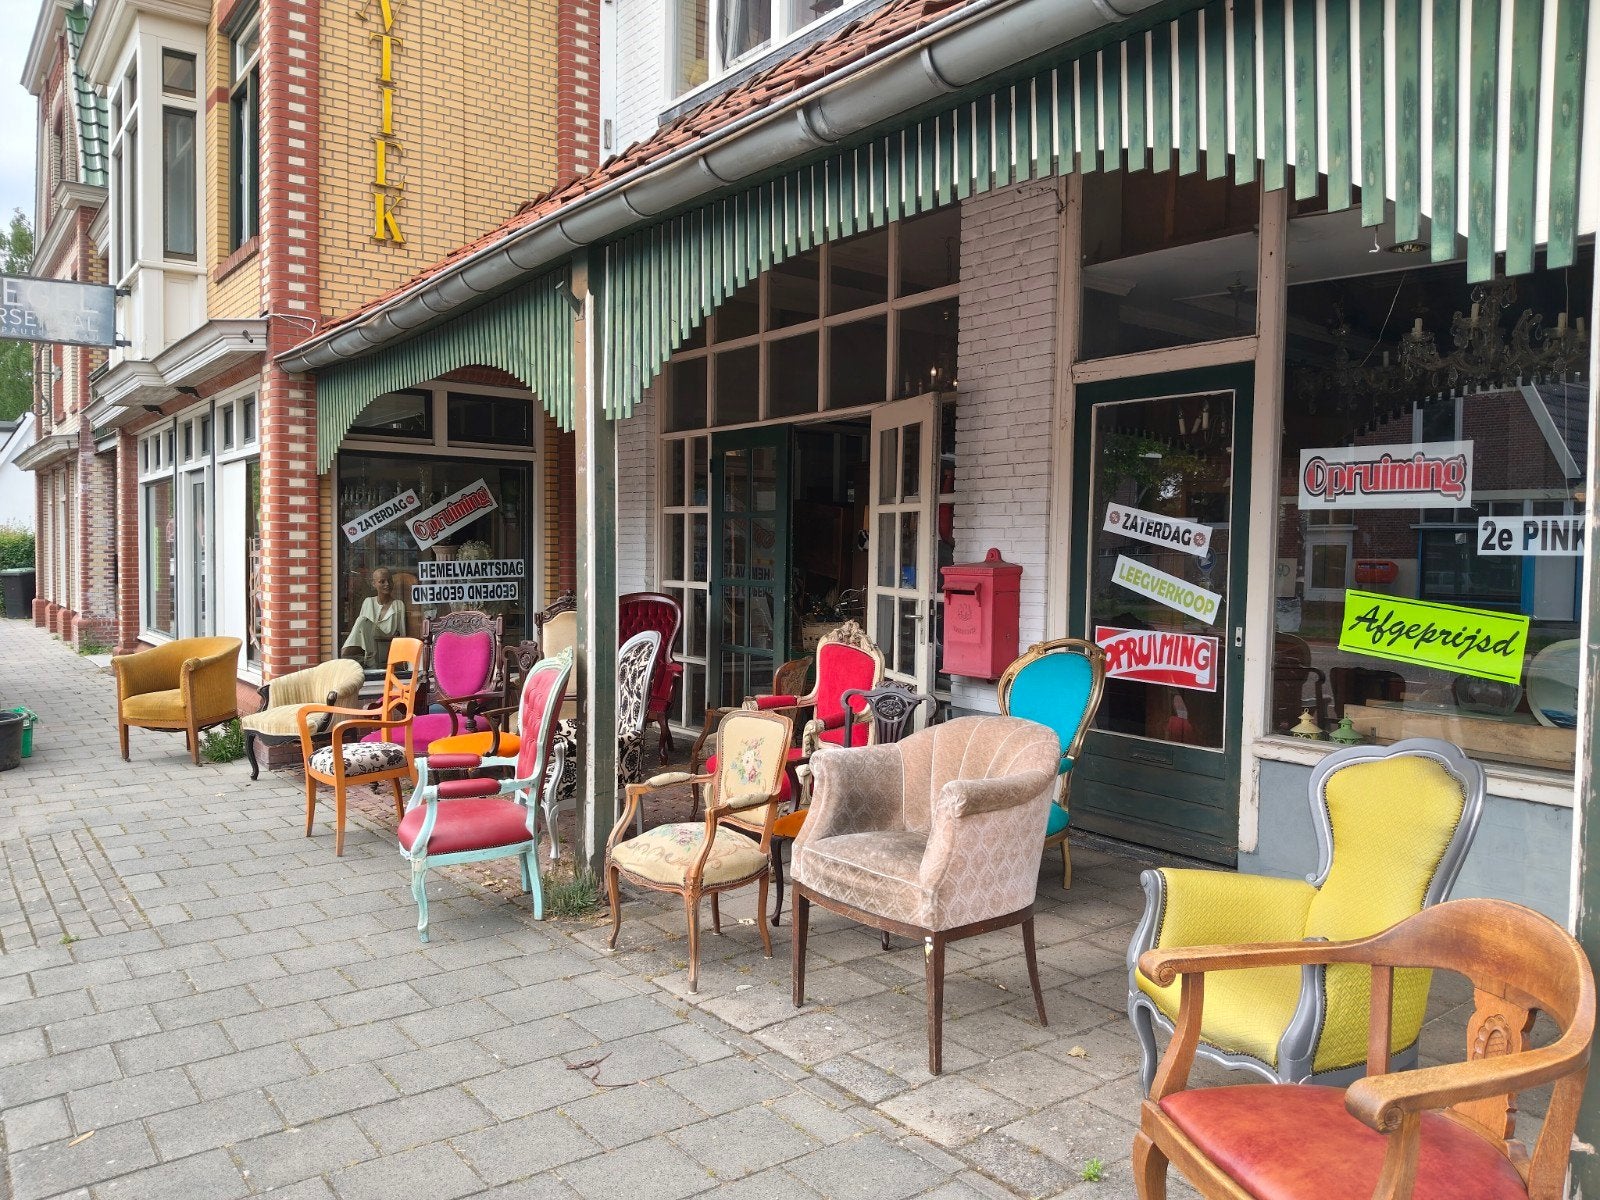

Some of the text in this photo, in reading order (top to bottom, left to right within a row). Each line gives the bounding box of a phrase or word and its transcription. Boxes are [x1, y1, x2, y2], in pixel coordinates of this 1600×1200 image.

[1303, 451, 1467, 502] Opruiming
[357, 498, 408, 533] ZATERDAG
[412, 486, 493, 540] Opruiming
[1121, 512, 1192, 546] ZATERDAG
[1481, 520, 1513, 551] 2e
[420, 561, 524, 578] HEMELVAARTSDAG
[412, 583, 517, 602] GEOPEND GEOPEND
[1119, 562, 1215, 616] LEEGVERKOOP
[1348, 604, 1520, 660] Afgeprijsd
[1104, 633, 1211, 673] OPRUIMING
